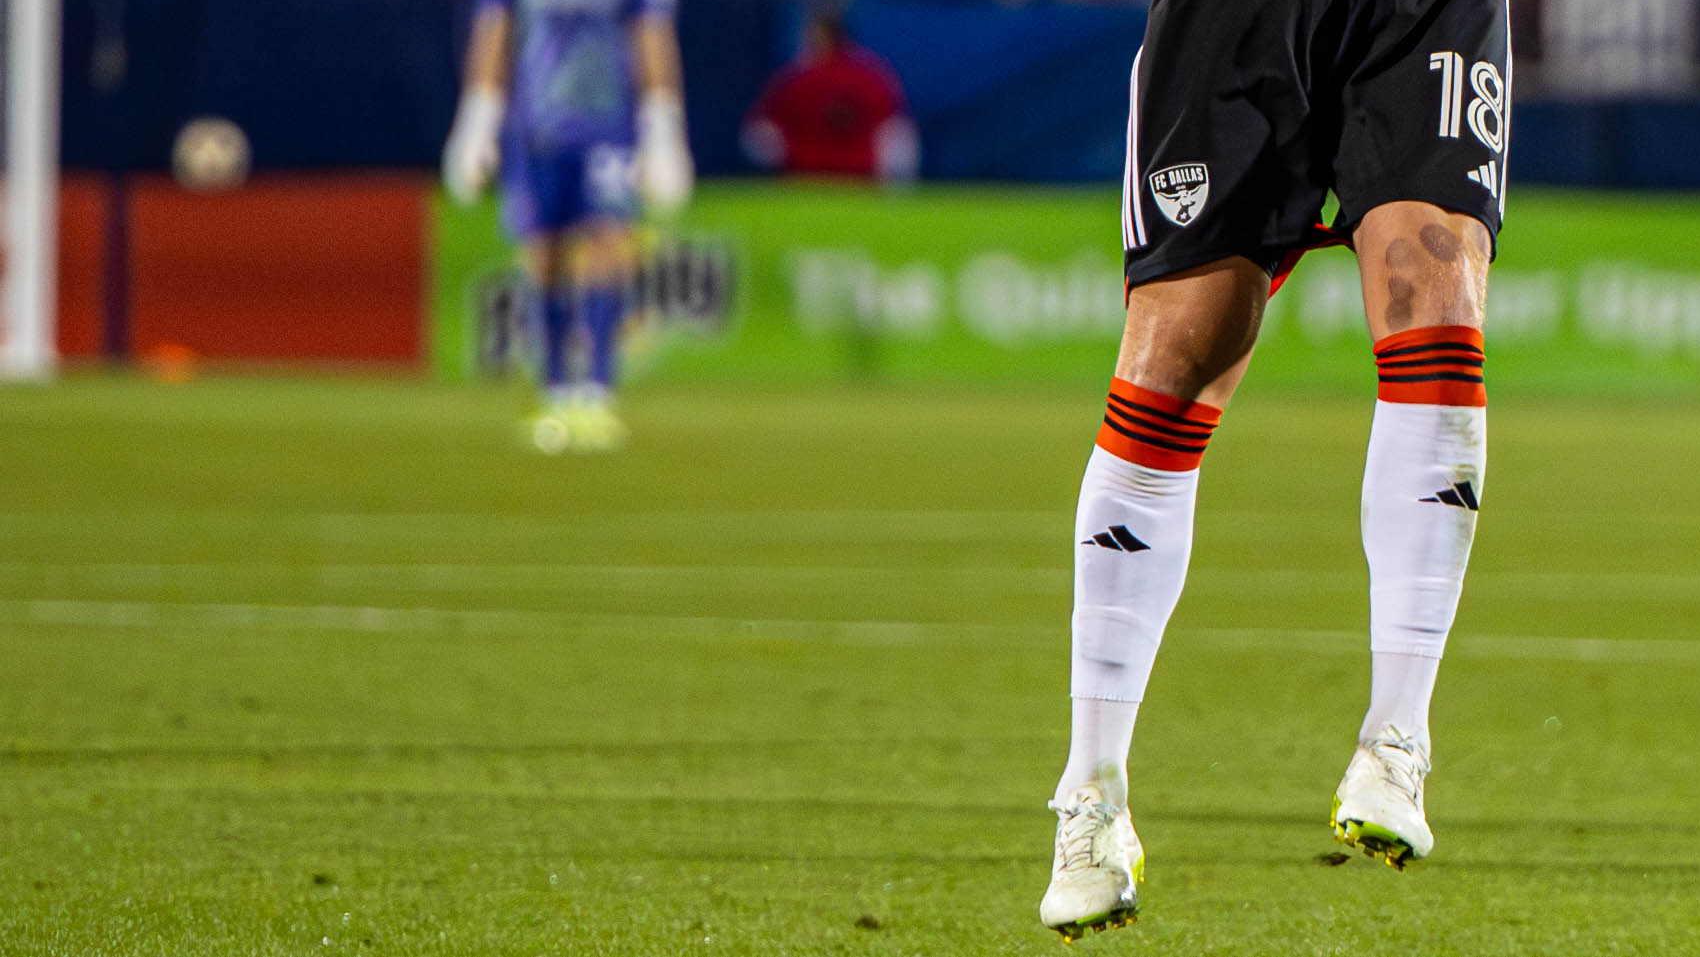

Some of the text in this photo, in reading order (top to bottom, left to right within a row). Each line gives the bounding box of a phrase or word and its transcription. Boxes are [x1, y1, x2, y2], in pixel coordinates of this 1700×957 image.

[1429, 51, 1504, 154] 18
[1155, 167, 1203, 190] FC DALLAS
